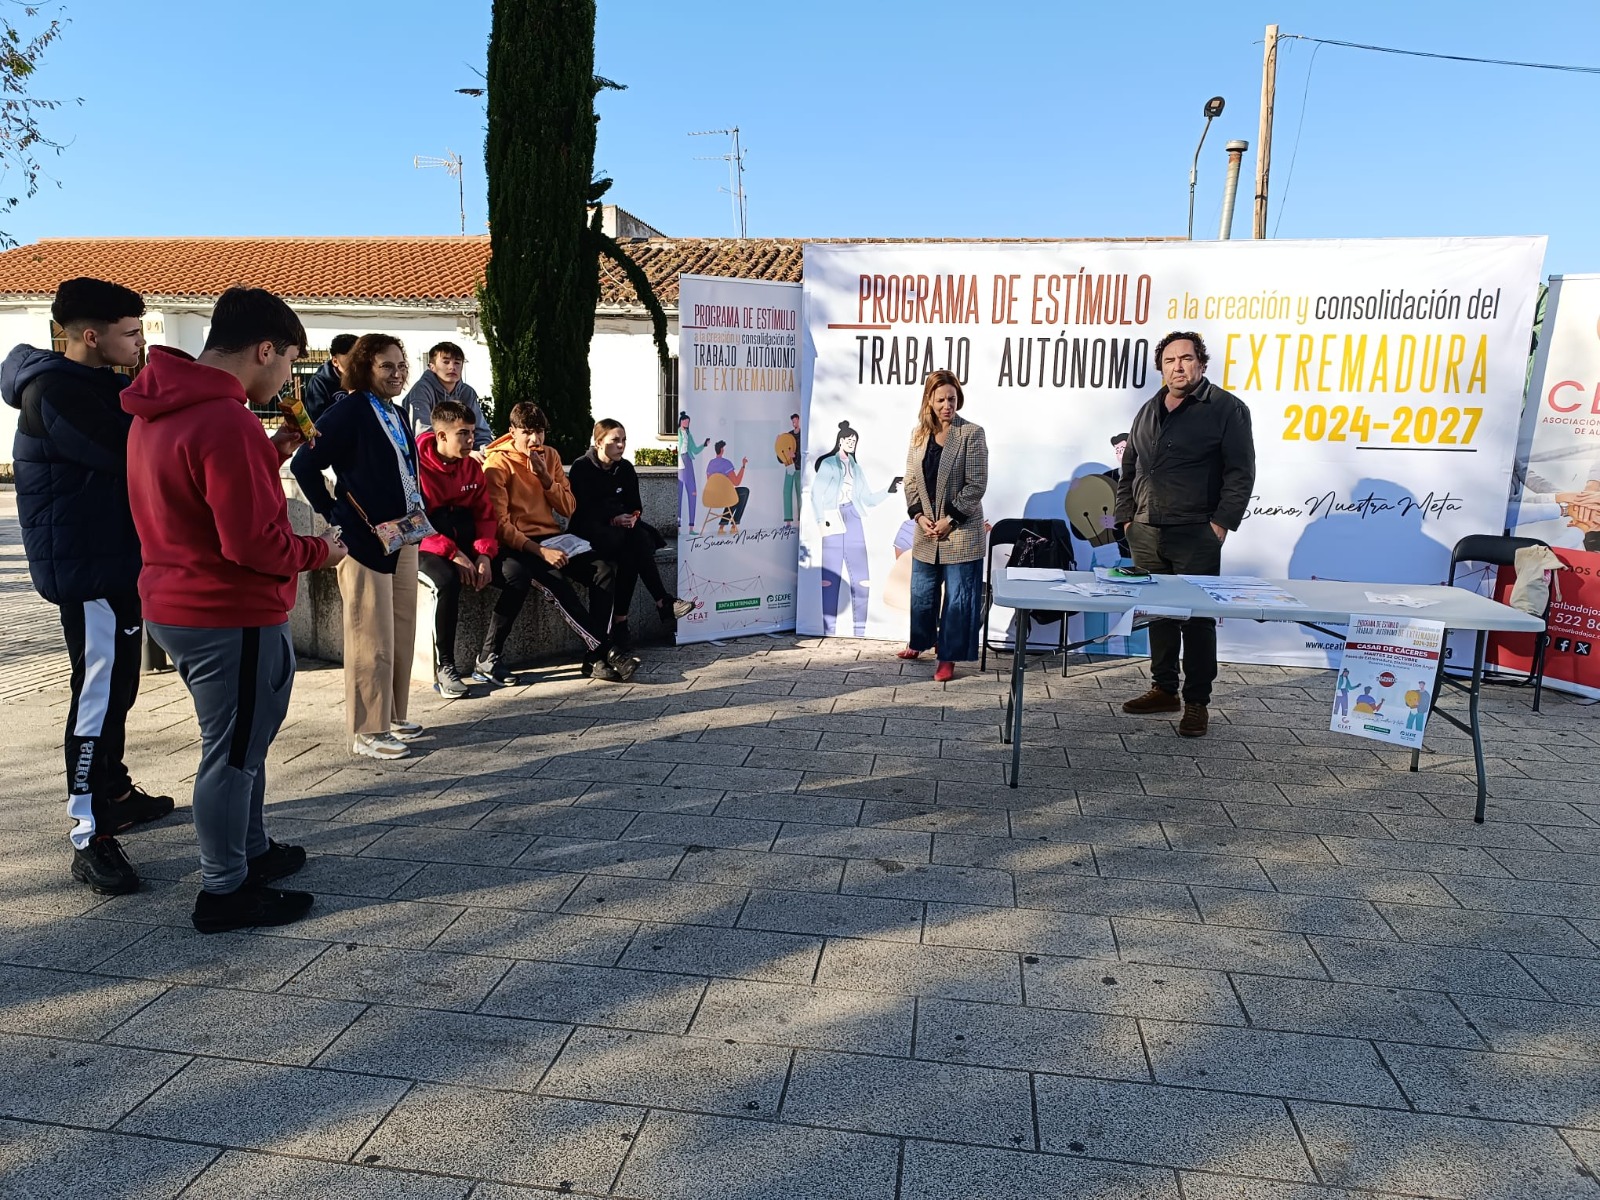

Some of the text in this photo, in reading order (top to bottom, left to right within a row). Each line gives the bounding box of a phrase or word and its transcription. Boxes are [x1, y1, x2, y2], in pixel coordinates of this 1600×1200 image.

[858, 267, 1152, 325] PROGRAMA DE ESTÍMULO
[1167, 288, 1502, 325] a la creación y consolidación del
[694, 304, 795, 330] PROGRAMA DE ESTÍMULO
[742, 333, 784, 345] consolidación
[786, 334, 795, 346] del
[693, 344, 795, 368] TRABAJO AUTÓNOMO
[855, 330, 1149, 389] TRABAJO AUTÓNOMO
[1222, 333, 1488, 394] EXTREMADURA
[694, 367, 794, 391] DE EXTREMADURA
[1282, 404, 1484, 445] 2024-2027
[1574, 427, 1587, 435] DE
[1304, 490, 1396, 520] Nuestra
[1397, 491, 1464, 520] Meta
[685, 537, 703, 552] Tu
[686, 612, 709, 621] CEAT
[1555, 612, 1582, 627] 522
